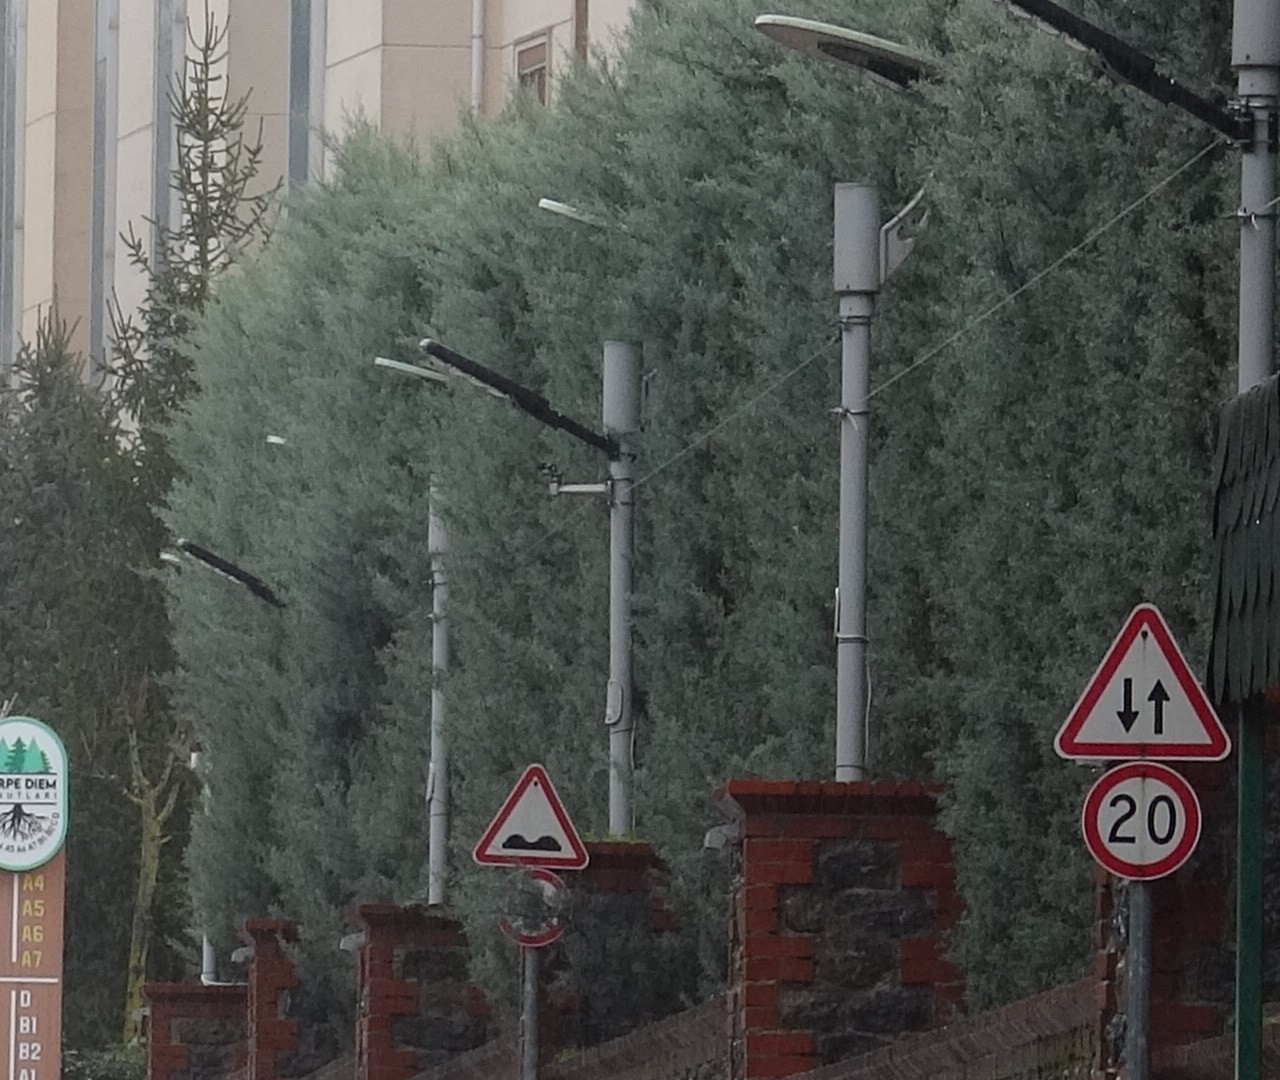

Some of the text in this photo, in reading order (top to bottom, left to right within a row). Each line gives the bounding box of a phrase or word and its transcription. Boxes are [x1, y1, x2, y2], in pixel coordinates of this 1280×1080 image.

[25, 778, 57, 790] DIEM
[1108, 794, 1176, 845] 20
[23, 873, 44, 891] A4
[22, 900, 45, 917] A5
[22, 925, 43, 942] A6
[21, 950, 42, 967] A7
[20, 990, 31, 1008] D
[19, 1016, 37, 1034] B1
[19, 1042, 41, 1060] B2
